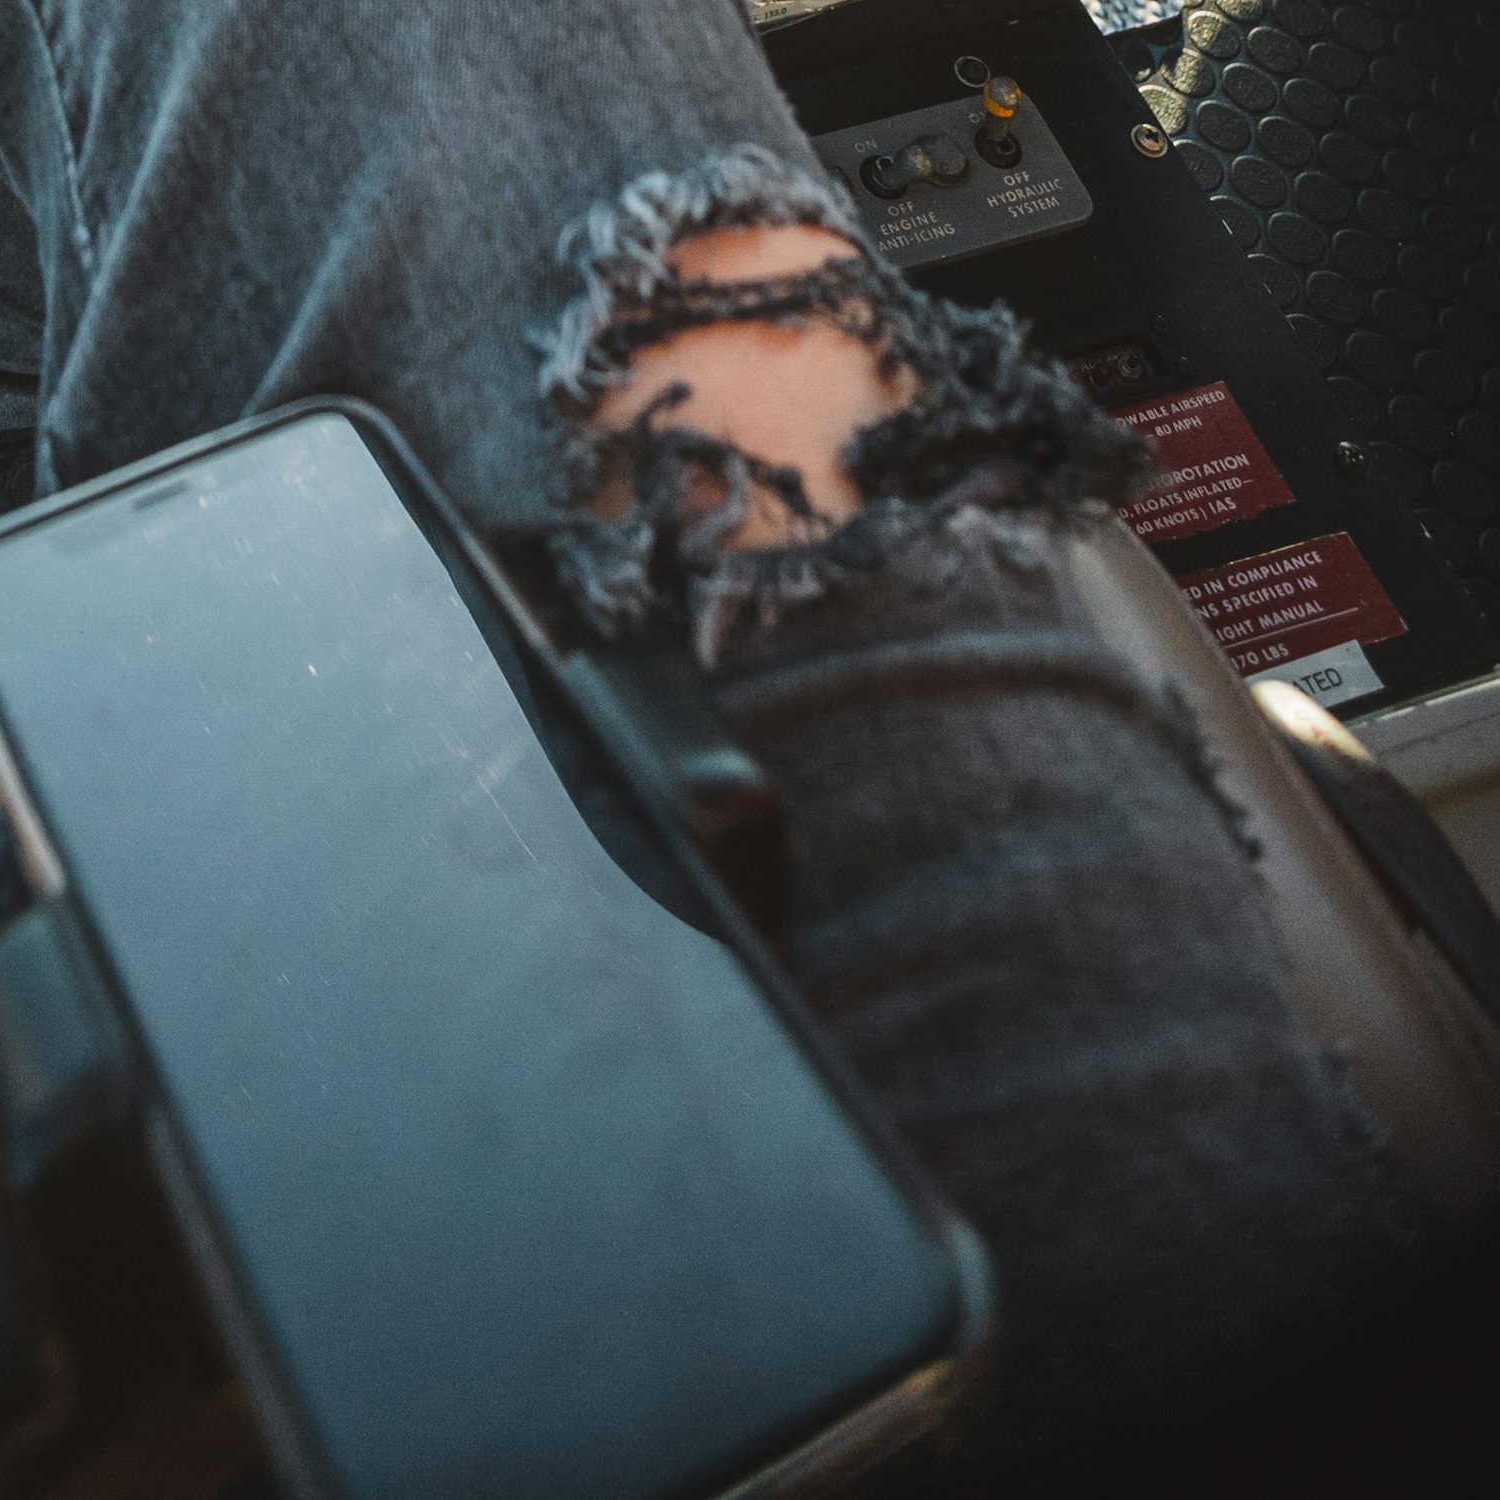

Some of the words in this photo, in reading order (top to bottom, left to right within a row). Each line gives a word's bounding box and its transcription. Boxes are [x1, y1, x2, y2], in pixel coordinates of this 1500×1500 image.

[1004, 171, 1030, 186] OFF
[987, 178, 1063, 208] HYDRAULIC
[1008, 196, 1060, 218] SYSTEM
[880, 212, 937, 236] ENGINE
[878, 223, 955, 252] ANTI-ICING
[1170, 390, 1225, 414] AIRSPEED
[1155, 424, 1171, 436] 80
[1174, 416, 1202, 431] MPH
[1134, 493, 1183, 515] FLOATS
[1135, 521, 1153, 535] 60
[1209, 497, 1237, 514] IAS
[1204, 579, 1224, 595] IN
[1228, 551, 1322, 587] COMPLIANCE
[1222, 582, 1295, 612] SPECIFIED
[1297, 576, 1318, 590] IN
[1258, 600, 1324, 629] MANUAL
[1263, 643, 1289, 661] LBS
